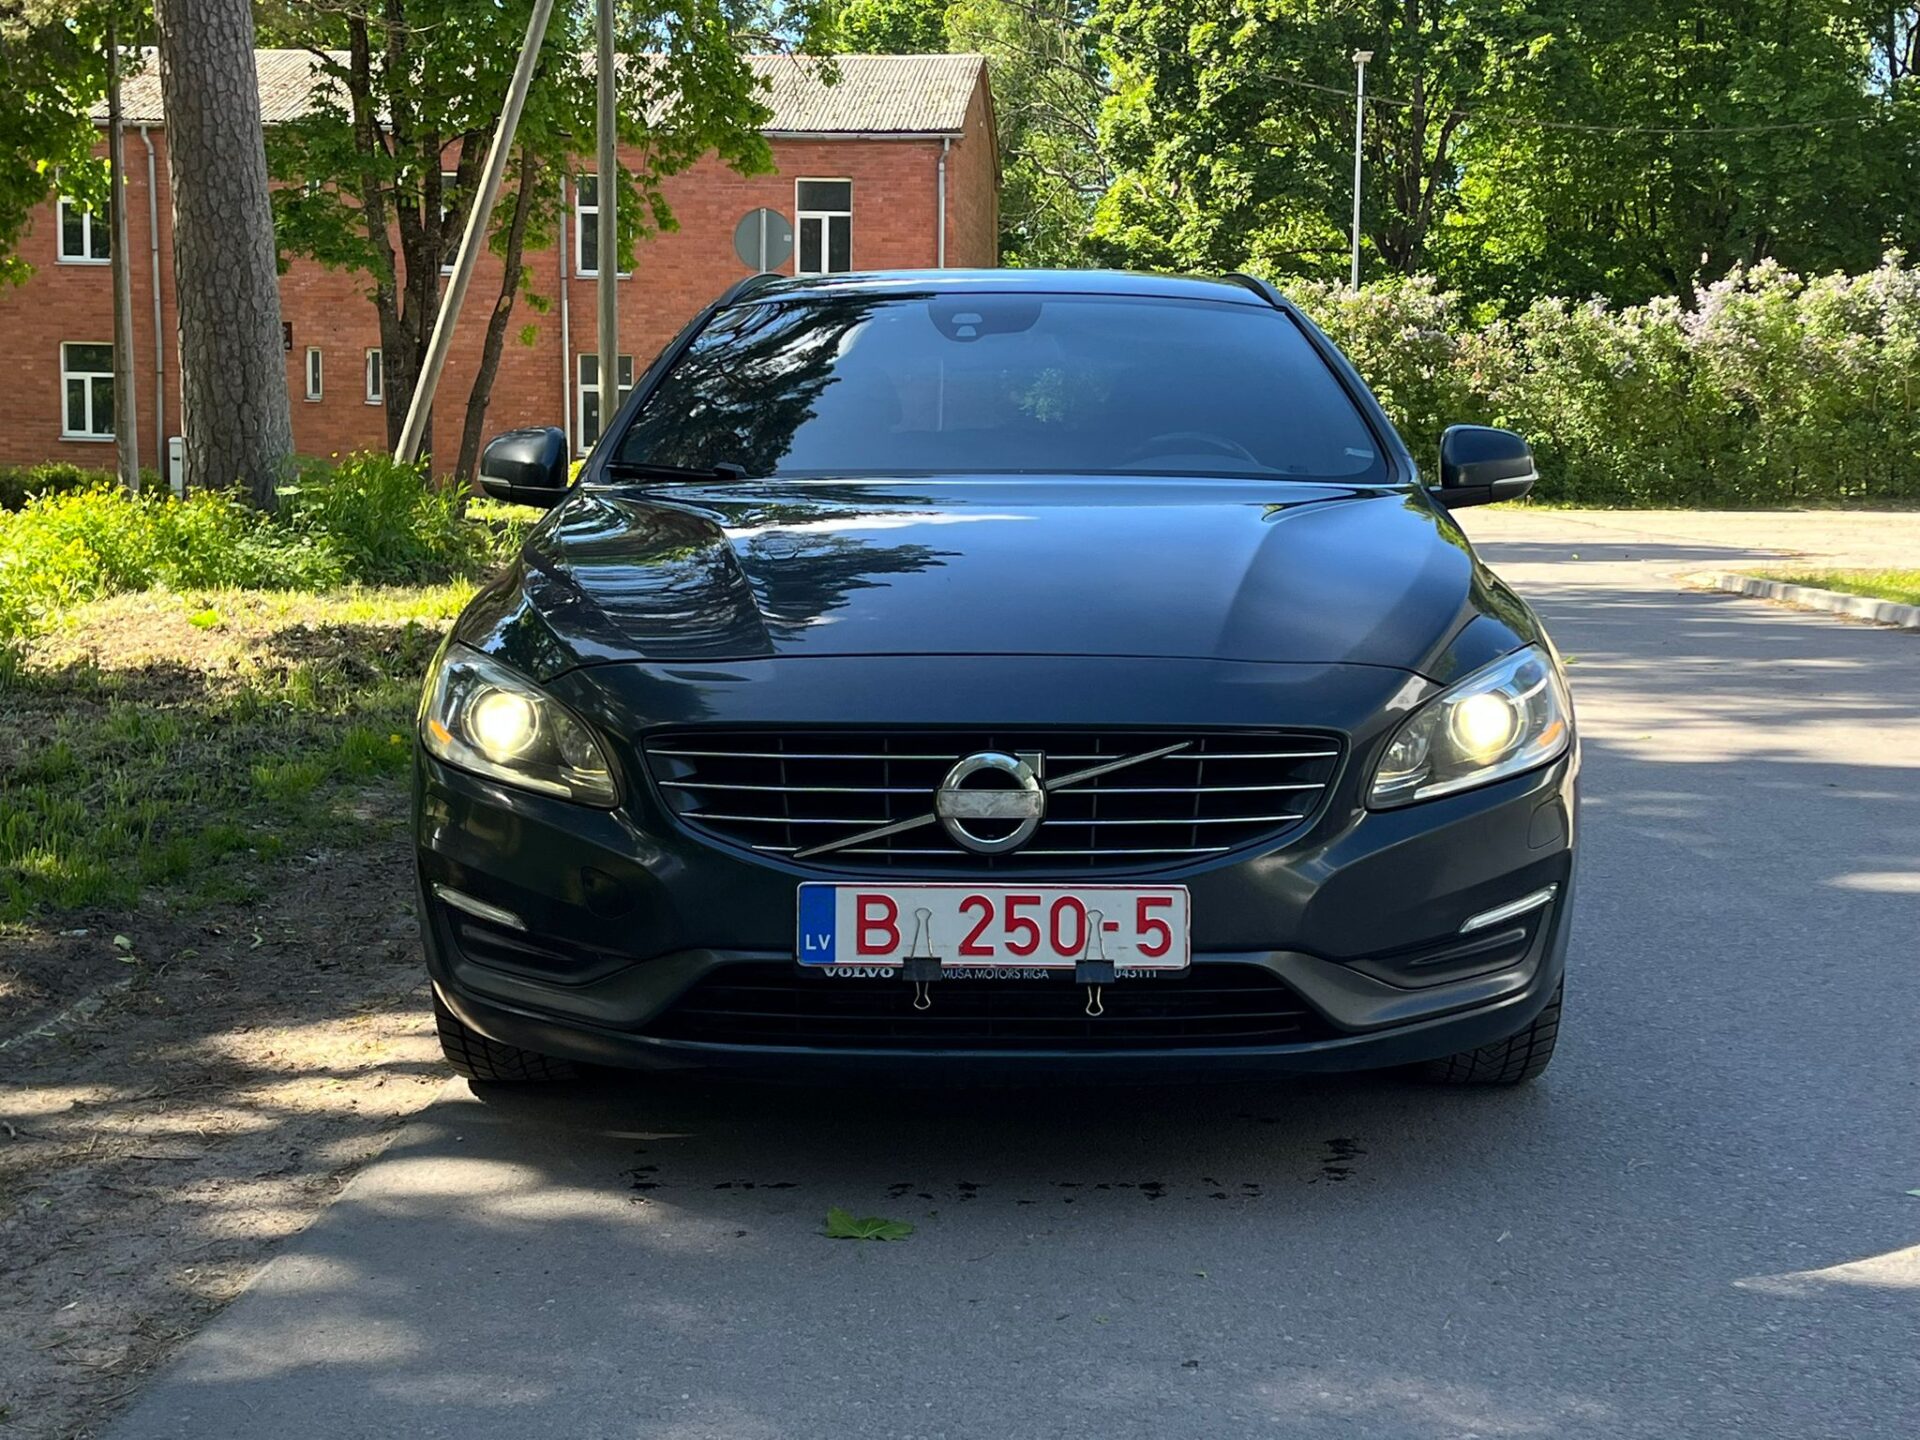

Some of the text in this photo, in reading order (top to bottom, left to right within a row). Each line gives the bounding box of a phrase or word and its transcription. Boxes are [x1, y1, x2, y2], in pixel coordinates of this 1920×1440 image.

[856, 893, 901, 955] B
[805, 934, 831, 950] LV
[823, 966, 895, 978] VOLVO
[974, 968, 1021, 979] MOTORS
[1023, 968, 1050, 979] RIGA
